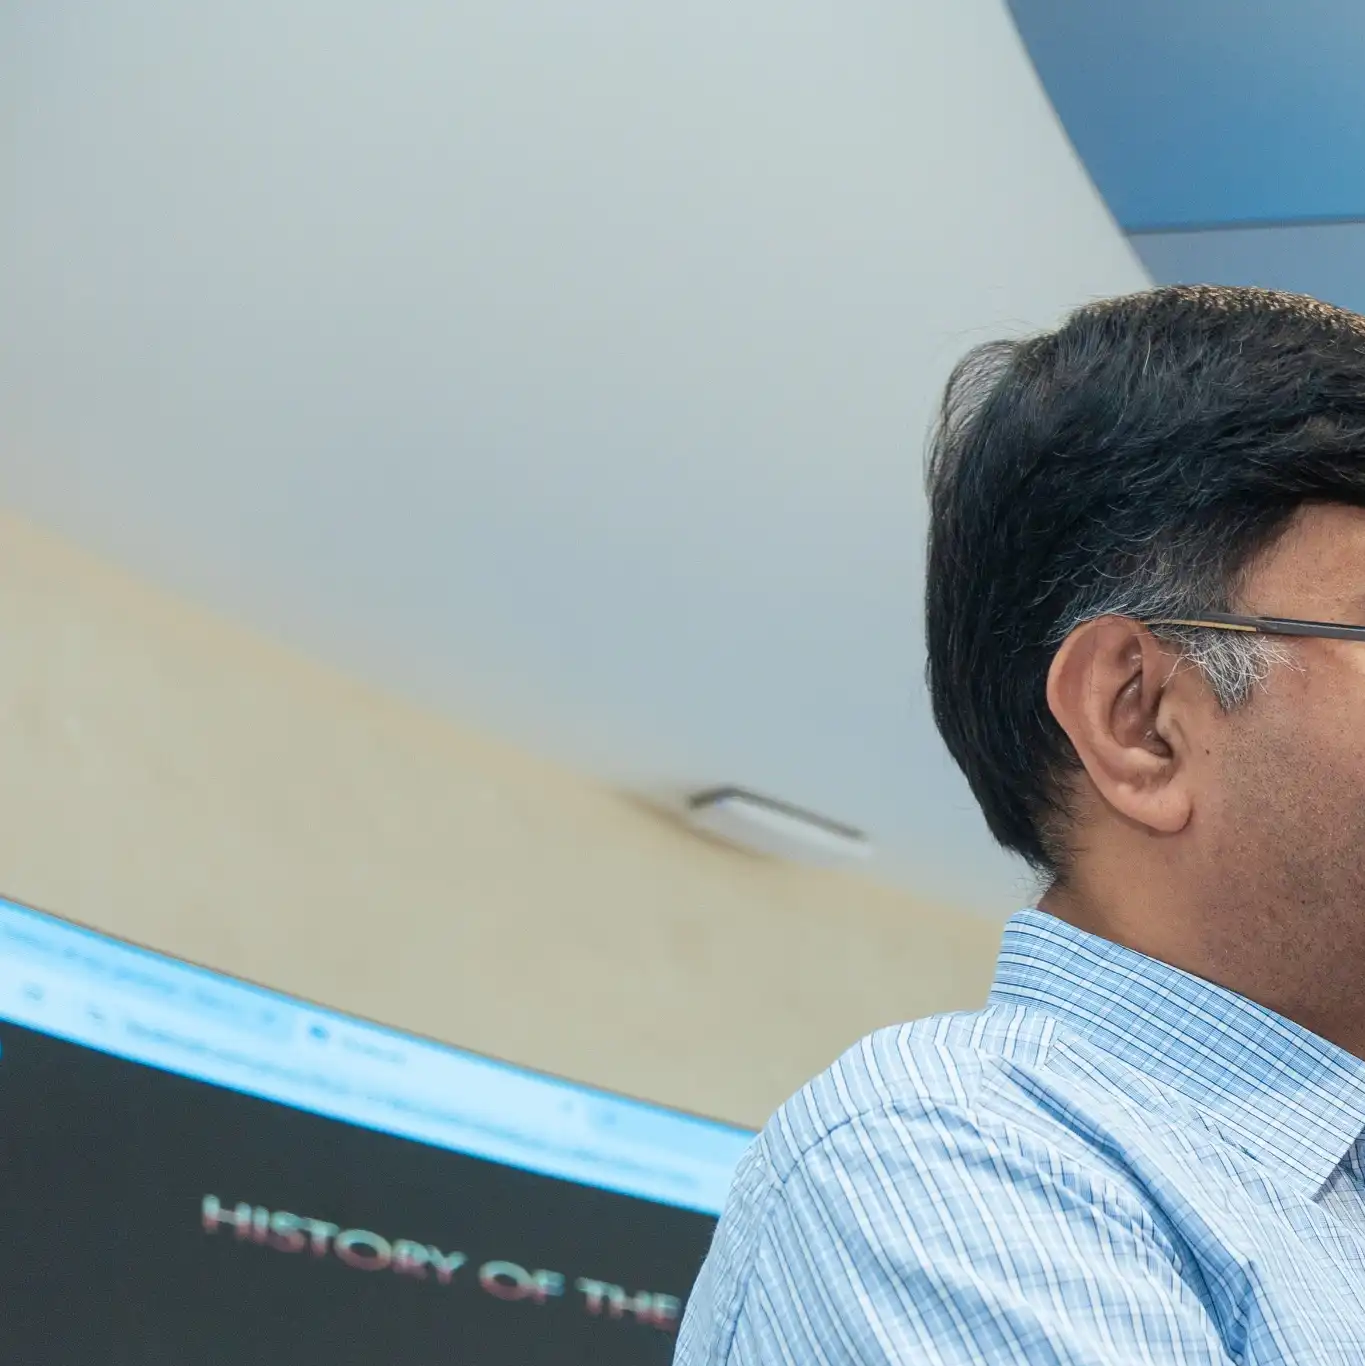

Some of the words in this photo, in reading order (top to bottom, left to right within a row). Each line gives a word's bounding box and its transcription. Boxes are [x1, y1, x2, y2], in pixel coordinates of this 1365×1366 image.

[203, 1194, 467, 1285] HISTORY
[478, 1260, 566, 1304] OF
[576, 1276, 682, 1333] THE
